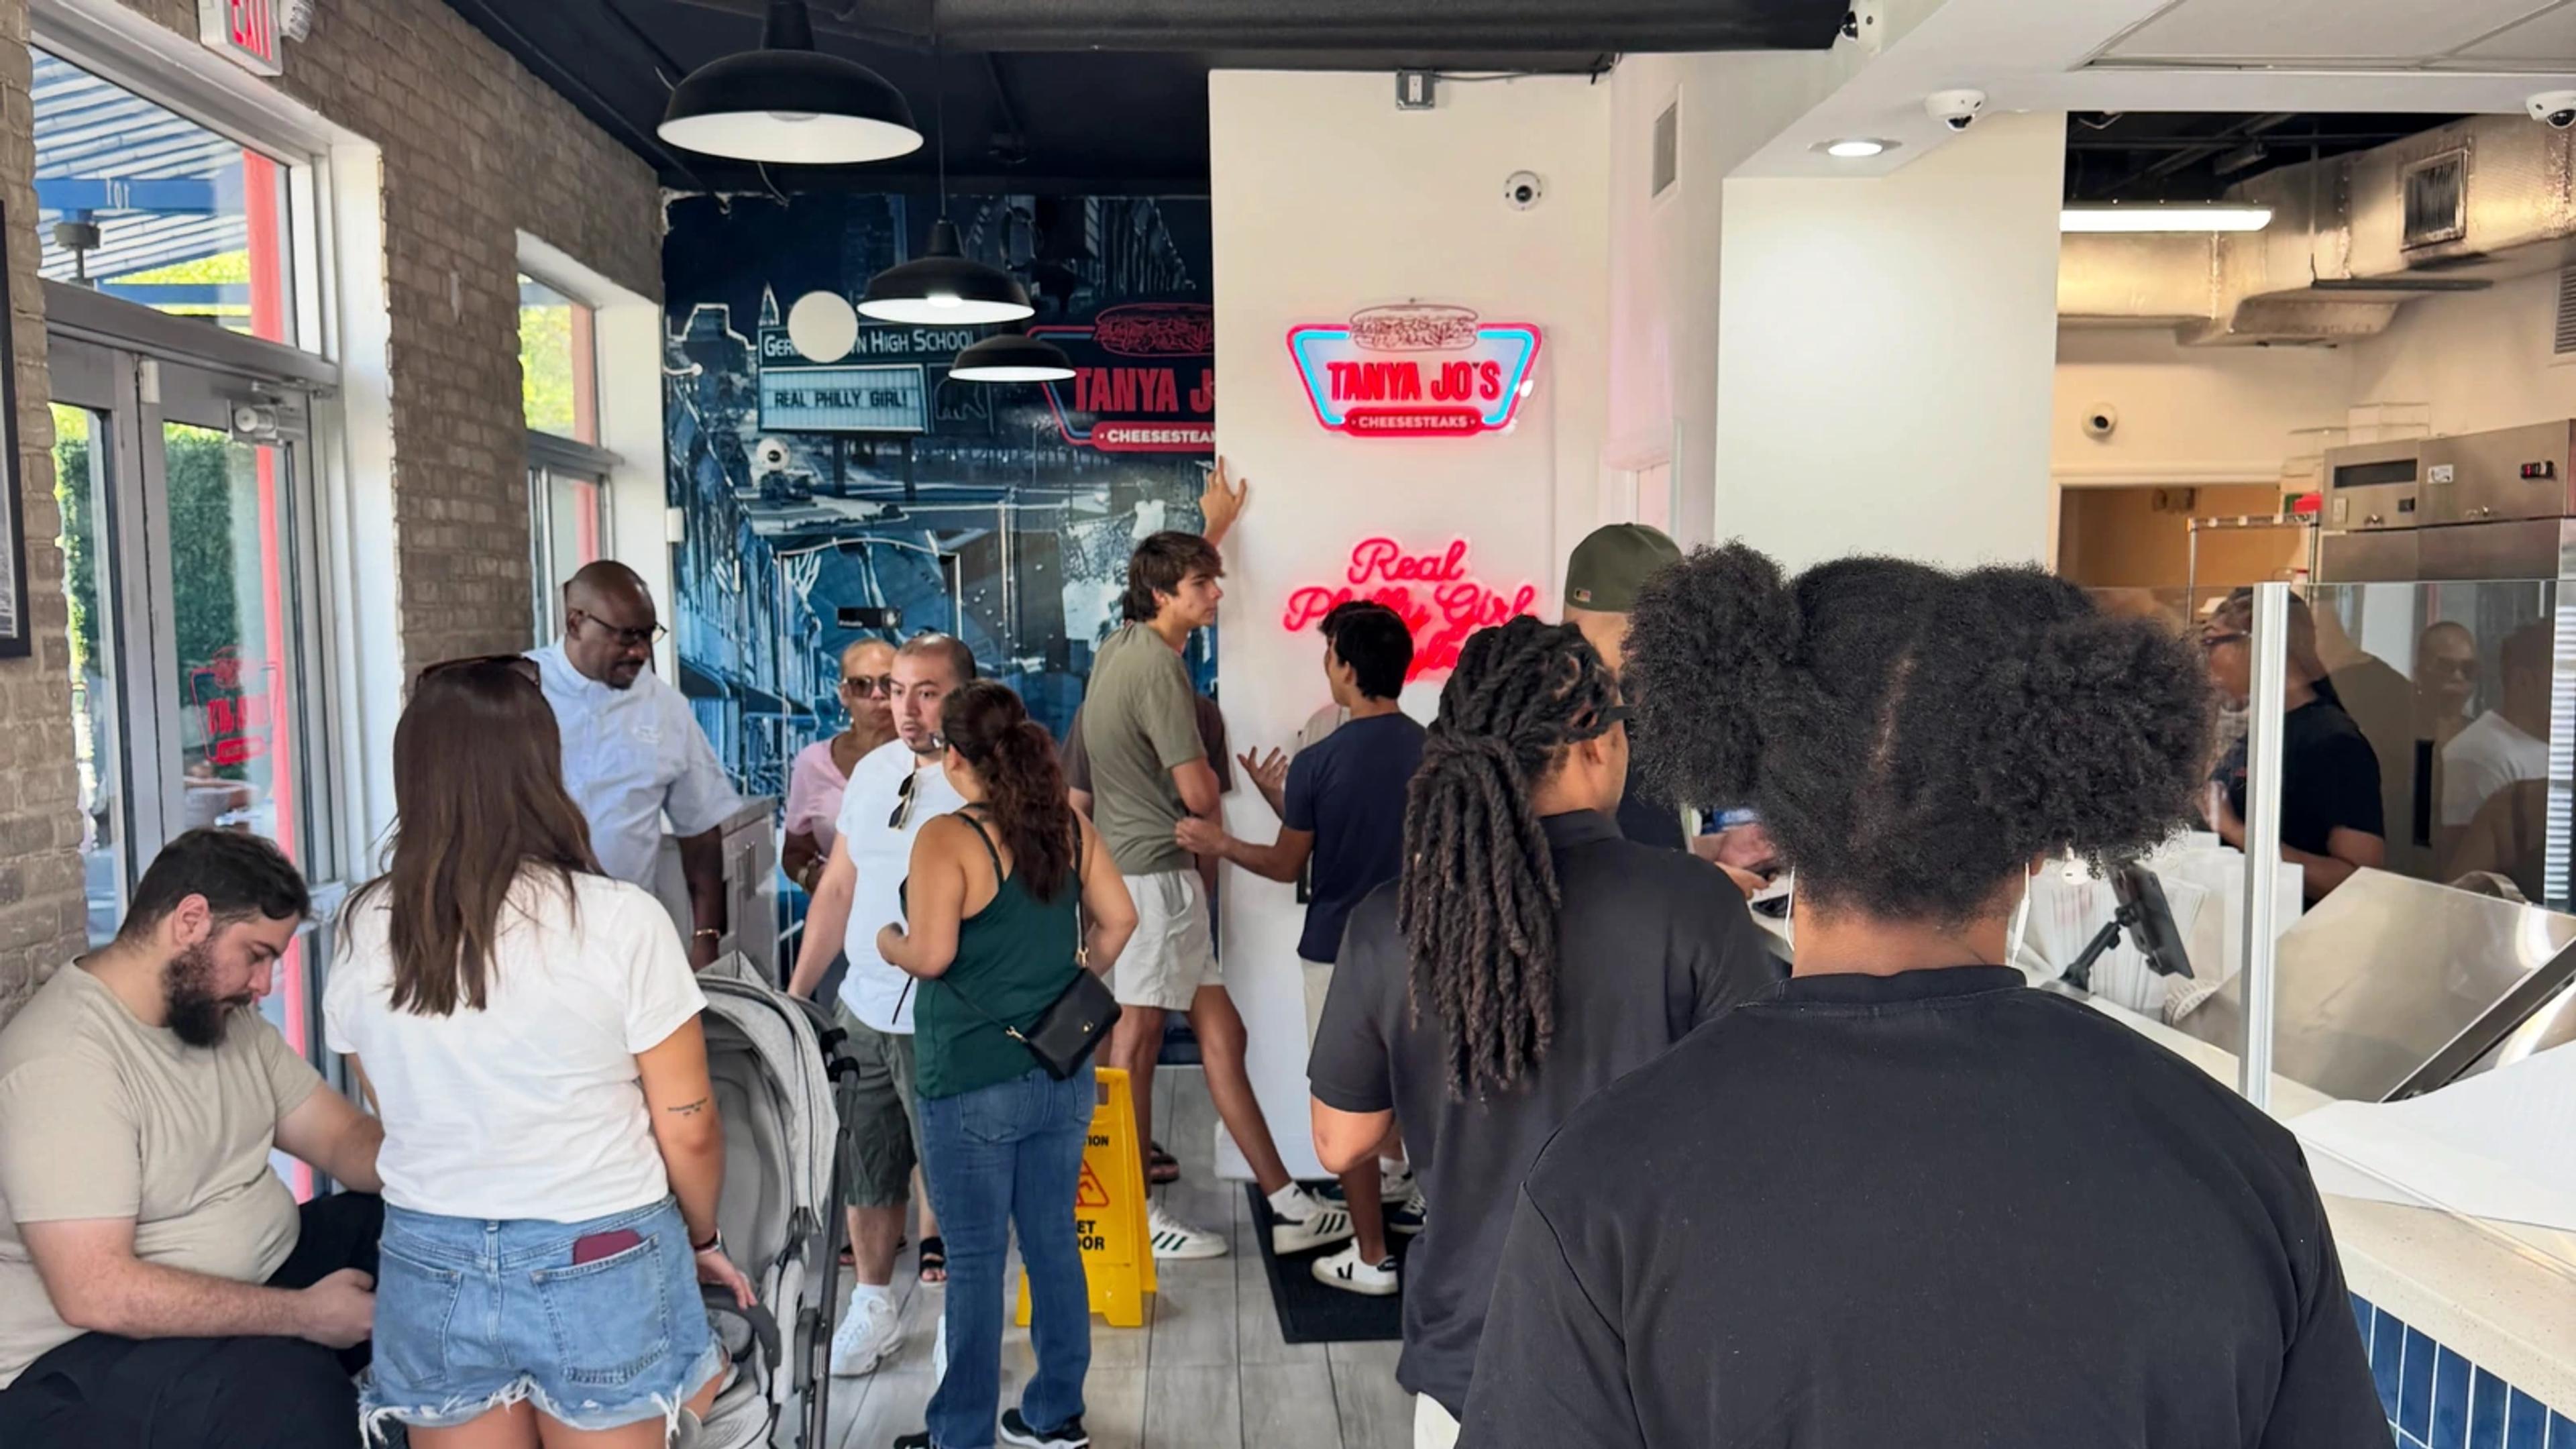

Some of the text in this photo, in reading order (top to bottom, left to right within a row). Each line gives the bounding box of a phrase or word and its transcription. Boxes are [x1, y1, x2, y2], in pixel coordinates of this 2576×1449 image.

[871, 331, 909, 353] HIGH
[1075, 367, 1179, 412] TANYA
[1326, 361, 1423, 401] TANYA
[775, 392, 806, 408] REAL
[814, 390, 861, 407] PHILLY
[1358, 415, 1468, 429] CHEESESTEAKS
[1348, 538, 1466, 584] Real
[1077, 1220, 1096, 1234] ET
